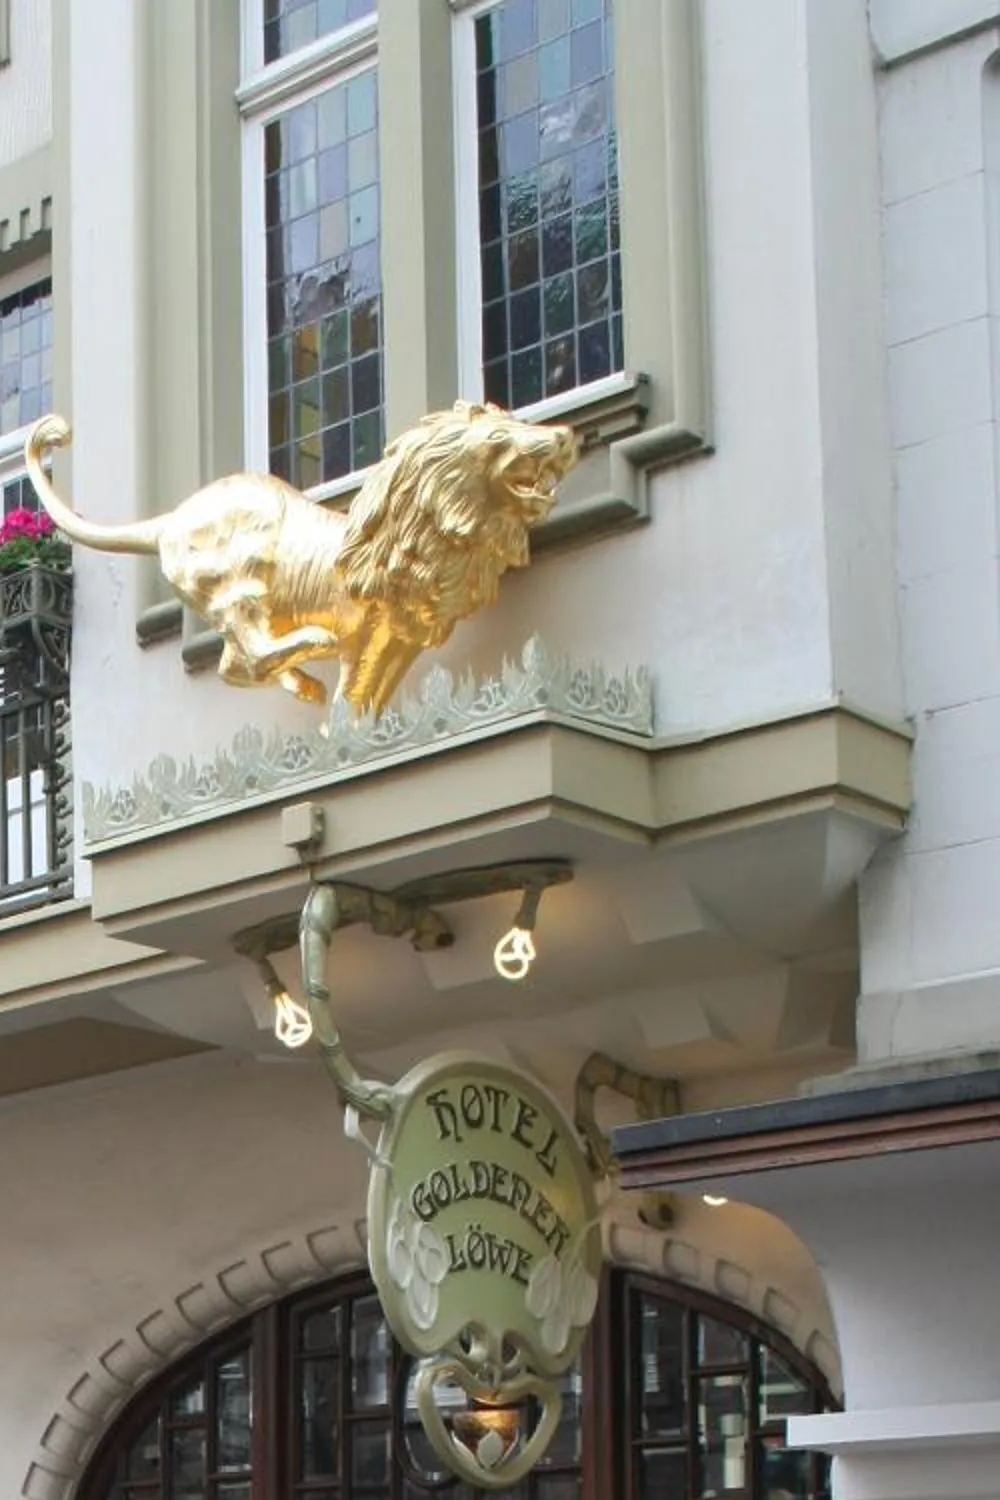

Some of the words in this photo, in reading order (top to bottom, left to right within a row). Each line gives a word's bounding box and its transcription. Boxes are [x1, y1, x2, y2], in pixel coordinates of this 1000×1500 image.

[425, 1084, 559, 1178] HOTEL
[412, 1160, 571, 1258] GOLDENER
[445, 1223, 534, 1286] LÖWE
